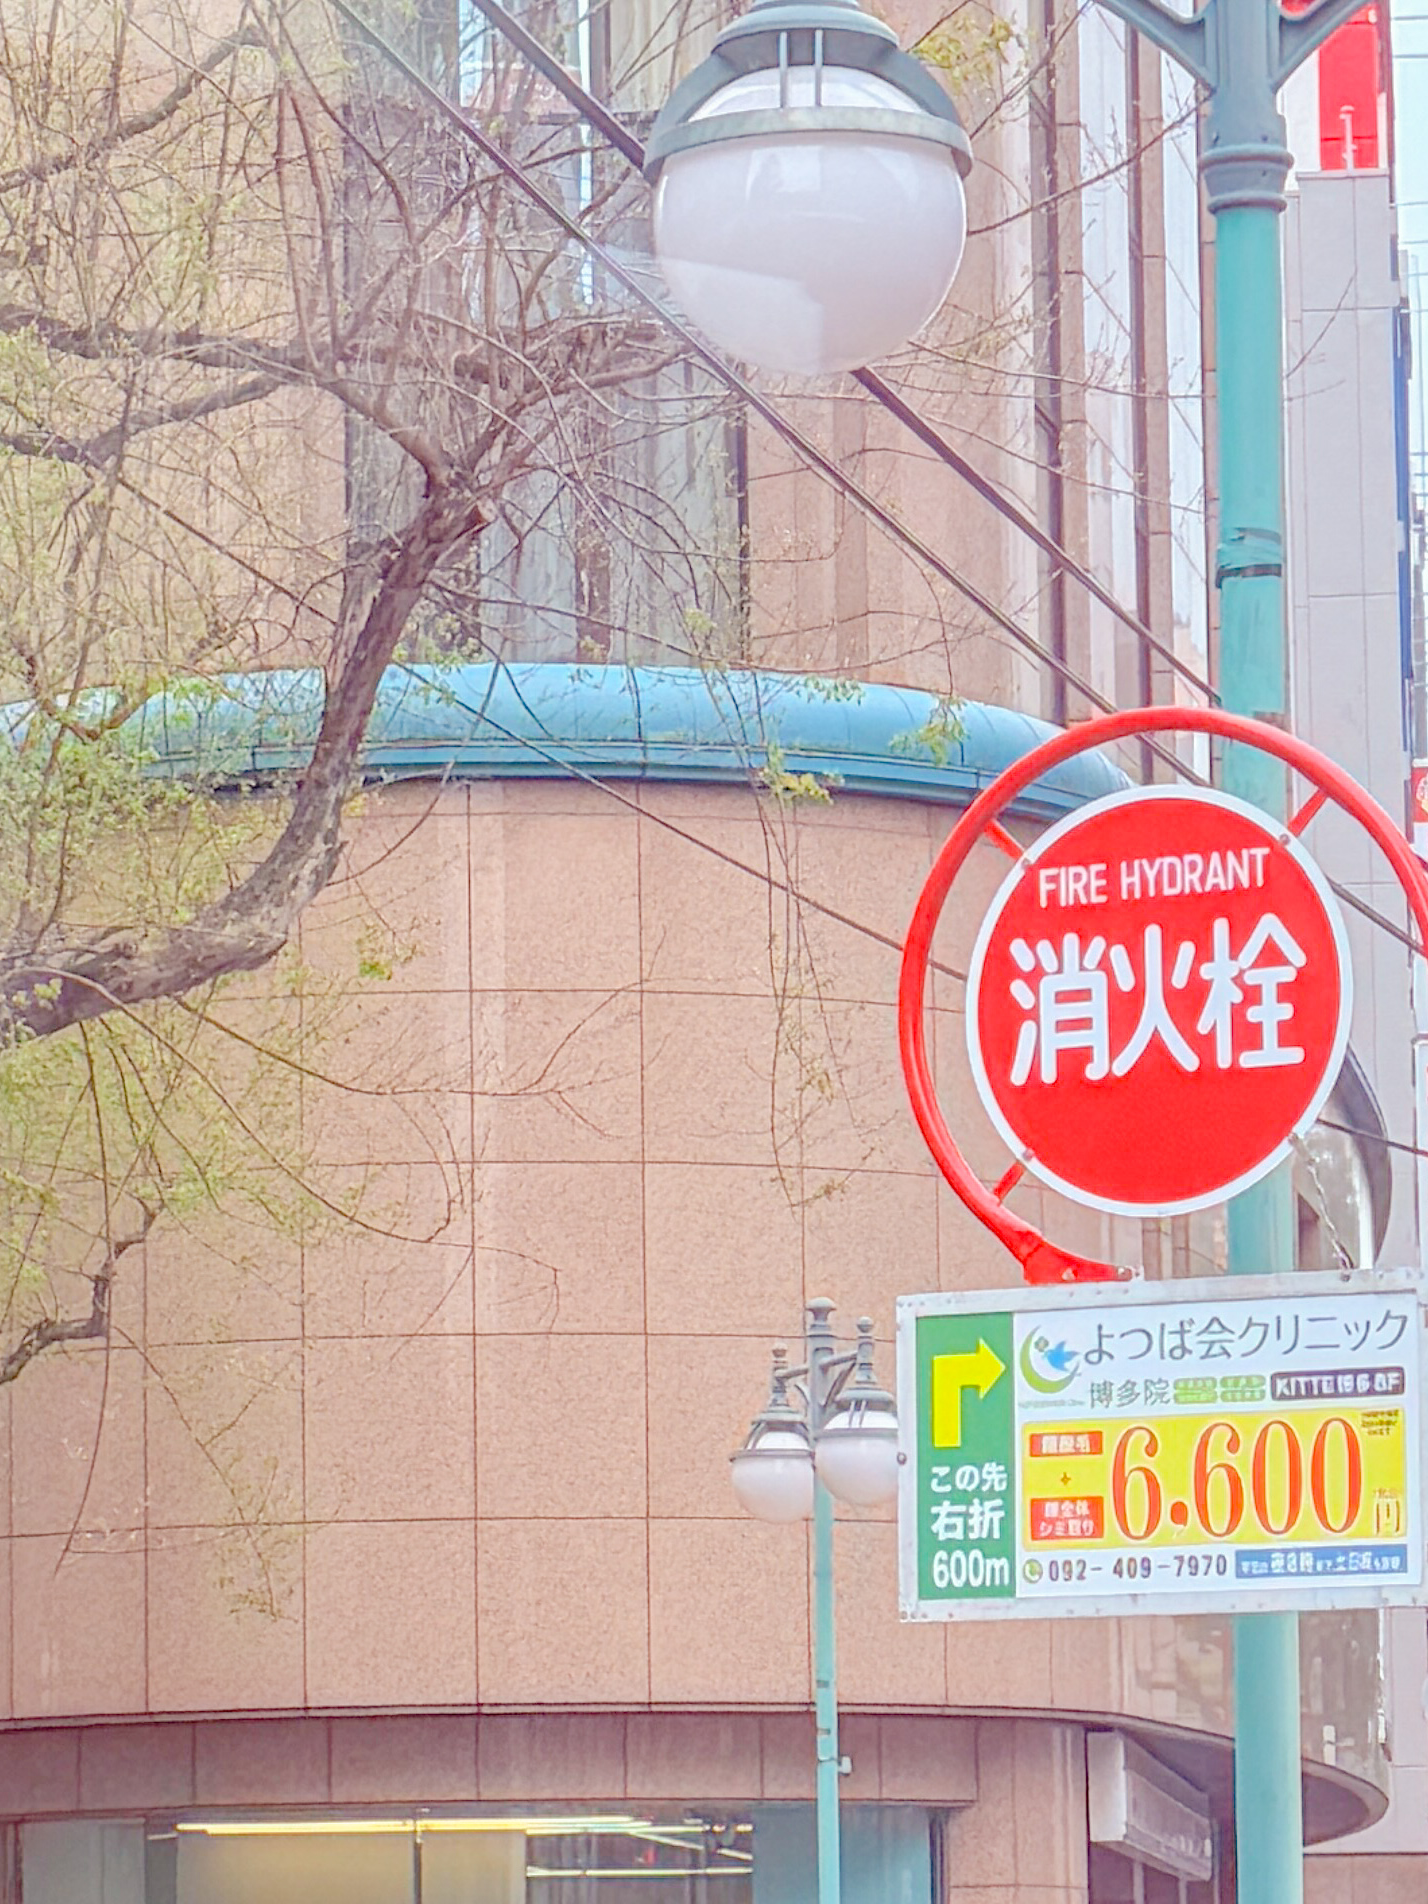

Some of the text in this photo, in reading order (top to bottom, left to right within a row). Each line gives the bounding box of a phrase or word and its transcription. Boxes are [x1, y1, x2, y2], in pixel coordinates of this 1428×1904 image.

[1039, 846, 1271, 909] FIRE HYDRANT
[1008, 912, 1308, 1087] 消火栓
[1083, 1308, 1409, 1365] よつば会クリニック
[1089, 1377, 1171, 1410] 博多院
[930, 1462, 1009, 1494] この先
[930, 1498, 1005, 1542] 右折
[932, 1549, 1010, 1588] 600m
